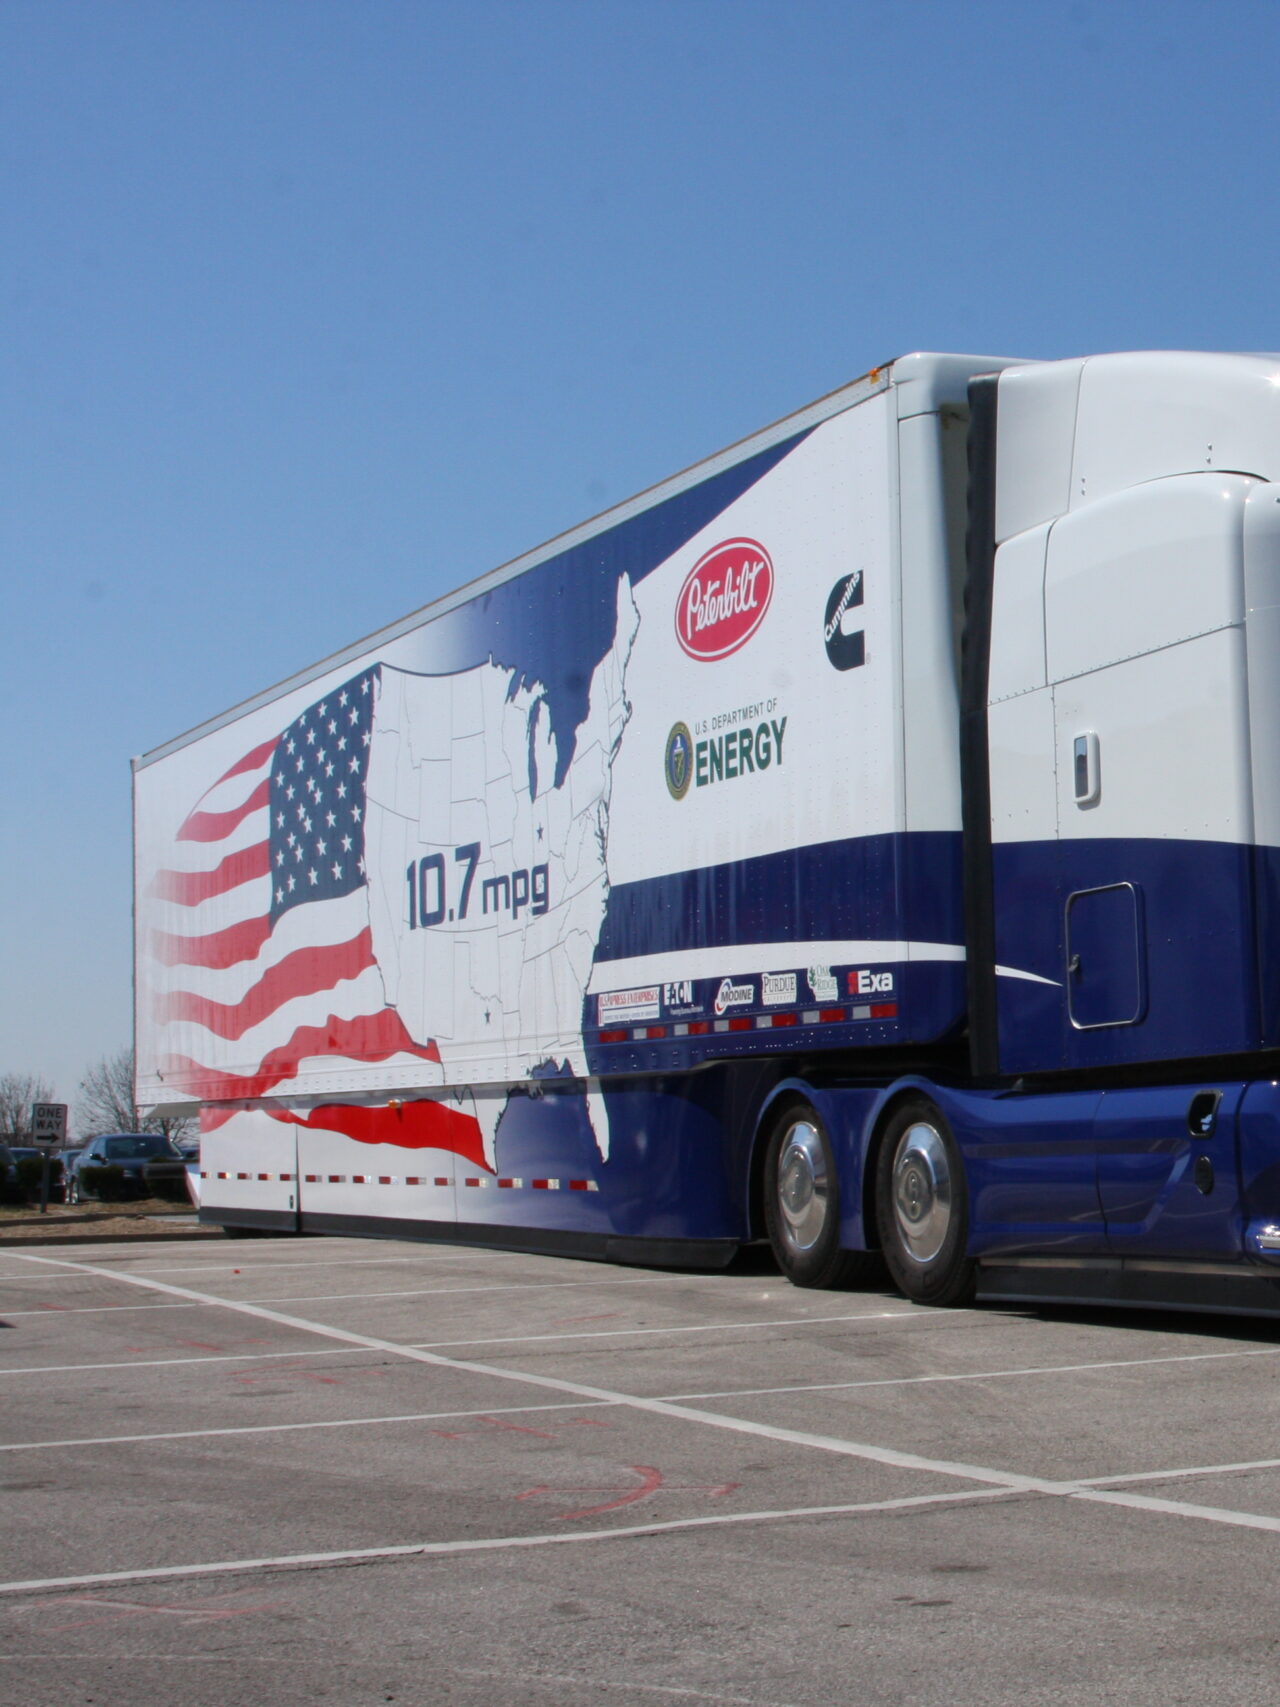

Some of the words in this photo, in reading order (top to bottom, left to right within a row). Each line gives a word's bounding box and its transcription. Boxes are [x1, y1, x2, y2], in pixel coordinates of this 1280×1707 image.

[687, 561, 764, 640] Peterbilt
[825, 573, 860, 642] Cummins
[695, 720, 708, 735] U.S.
[712, 702, 764, 730] DEPARTMENT
[766, 697, 778, 713] OF
[696, 716, 787, 787] ENERGY
[407, 841, 481, 930] 10.7
[482, 862, 549, 920] mpg
[720, 988, 752, 1002] MODINE
[763, 975, 795, 993] PURDUE
[858, 970, 893, 994] Exa
[36, 1119, 62, 1130] WAY
[37, 1107, 62, 1118] ONE
